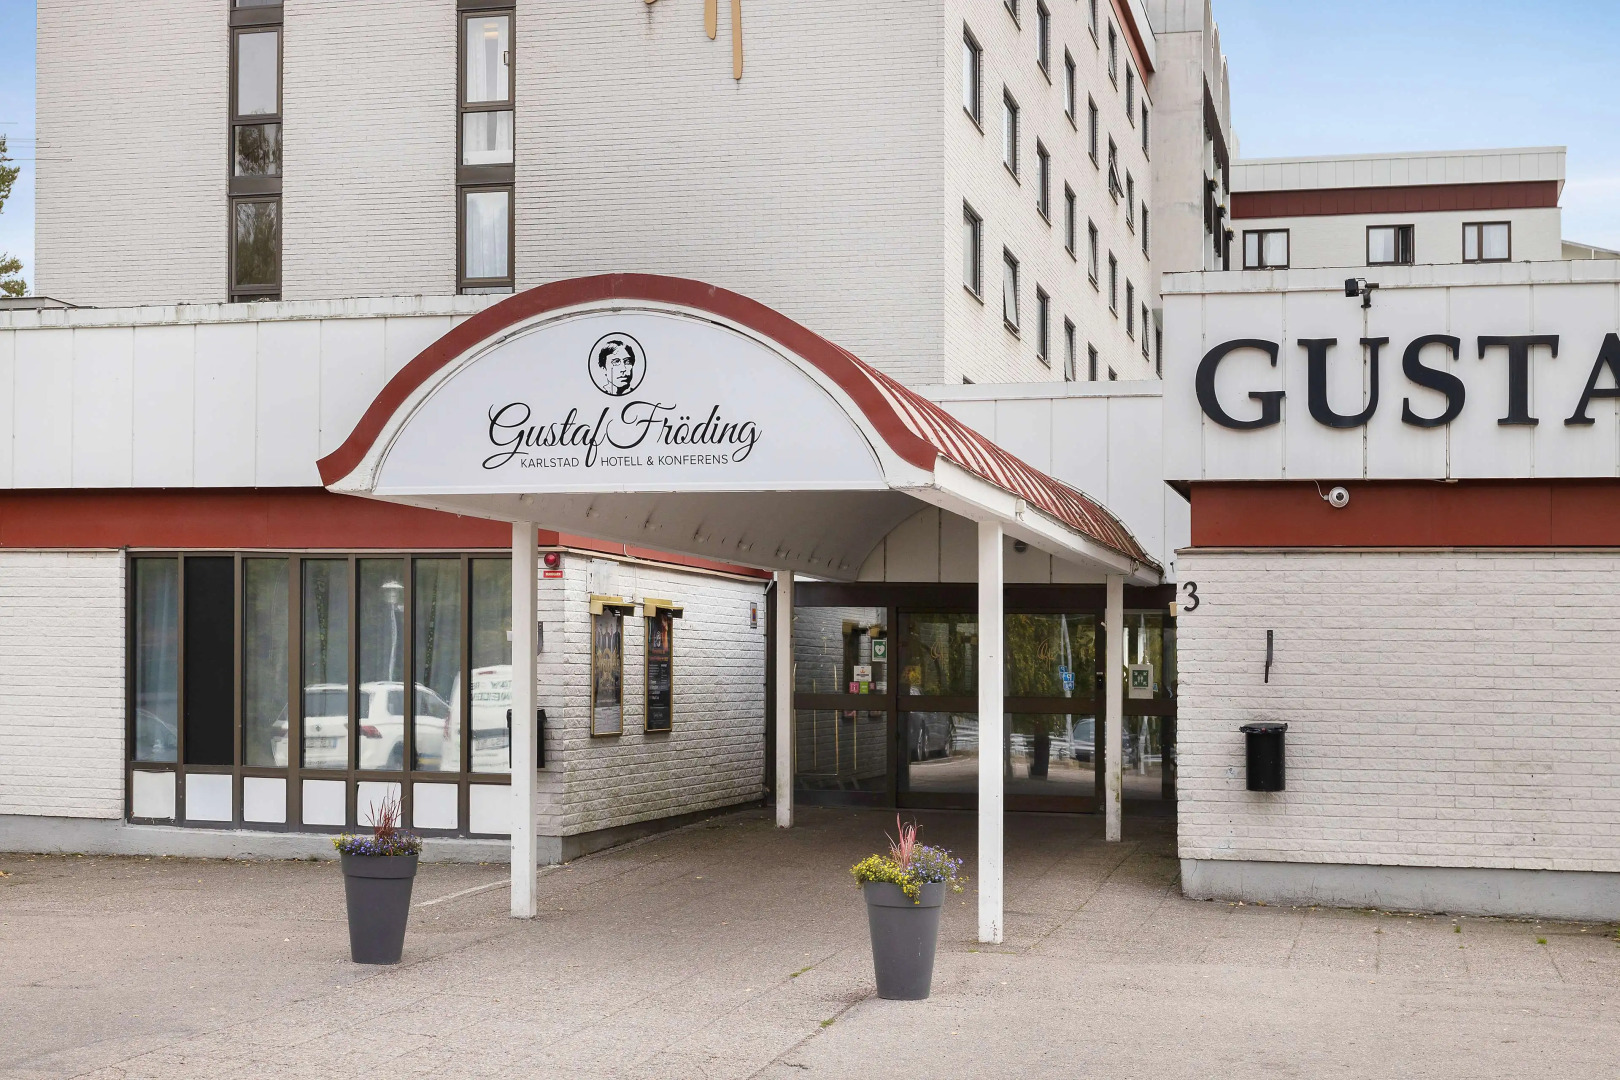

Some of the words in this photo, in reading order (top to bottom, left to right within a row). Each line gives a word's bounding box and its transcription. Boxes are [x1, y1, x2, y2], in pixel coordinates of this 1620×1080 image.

[1195, 332, 1620, 430] GUSTA
[481, 402, 609, 470] Gustaf
[606, 400, 763, 464] Fröding
[520, 457, 580, 468] KARLSTAD
[600, 456, 643, 467] HOTELL
[646, 455, 654, 466] &
[658, 454, 729, 466] KONFERENS
[1182, 581, 1200, 612] 3
